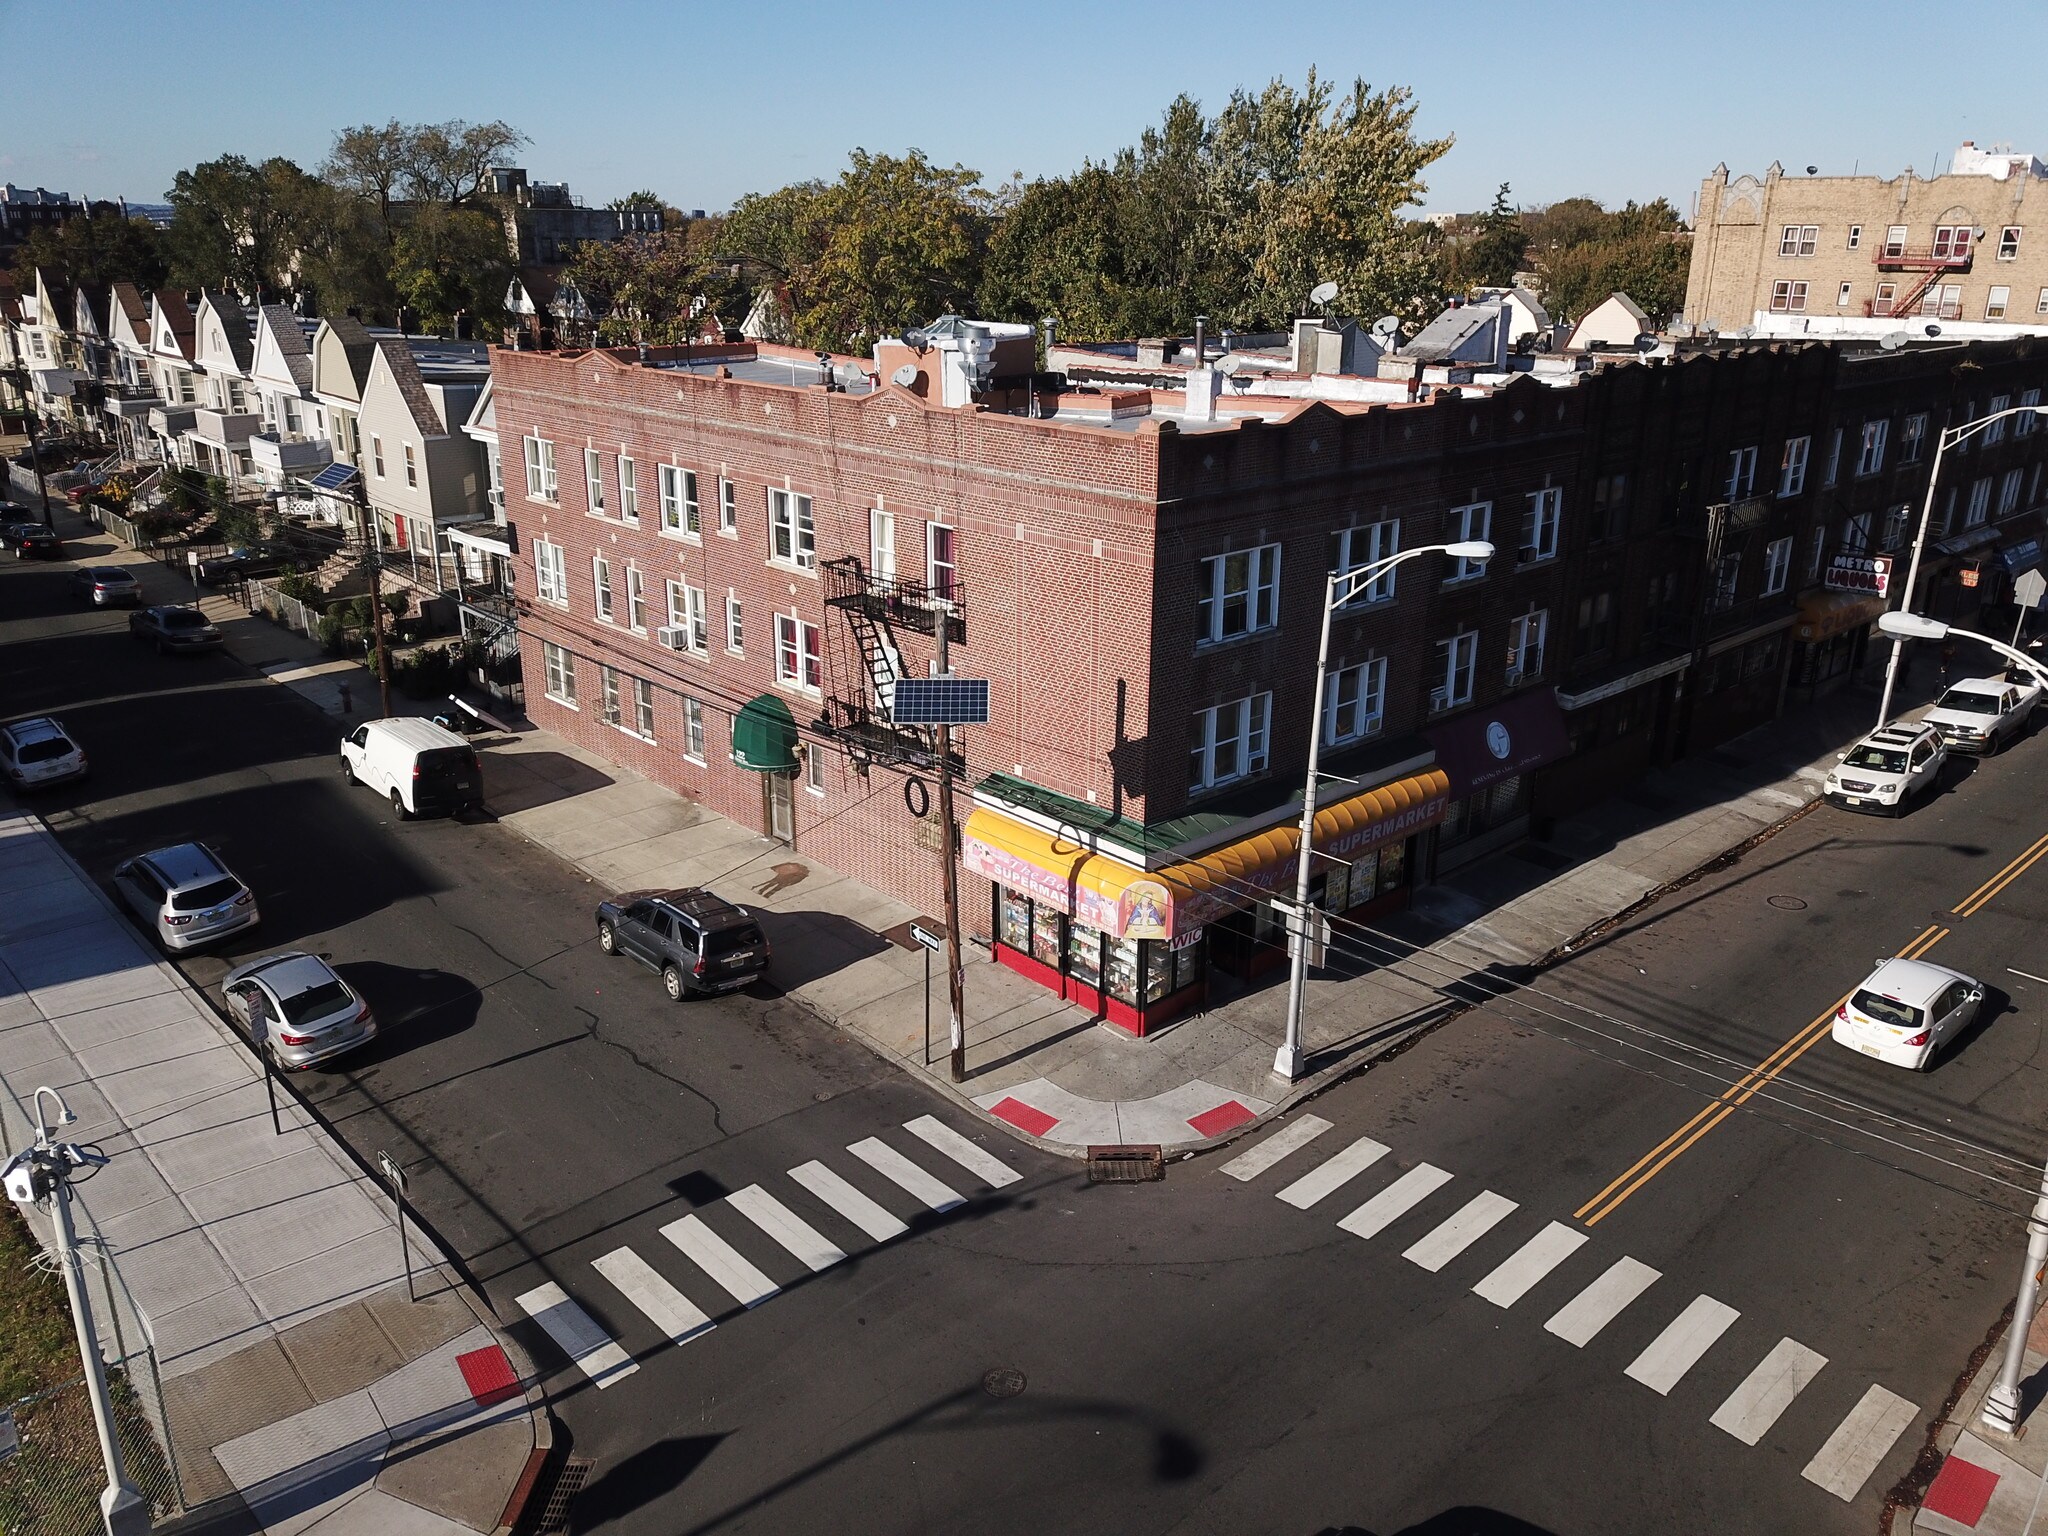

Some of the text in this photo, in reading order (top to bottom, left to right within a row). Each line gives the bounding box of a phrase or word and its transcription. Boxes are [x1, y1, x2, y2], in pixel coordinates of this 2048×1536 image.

[1834, 556, 1885, 573] METRO
[1827, 569, 1886, 590] LIQUORS
[1328, 797, 1446, 856] SUPERMARKET
[1007, 857, 1040, 880] The
[1244, 855, 1317, 893] The Bt
[993, 862, 1100, 919] SUPERMARKET
[928, 938, 936, 946] WAY
[1173, 928, 1202, 949] WIC
